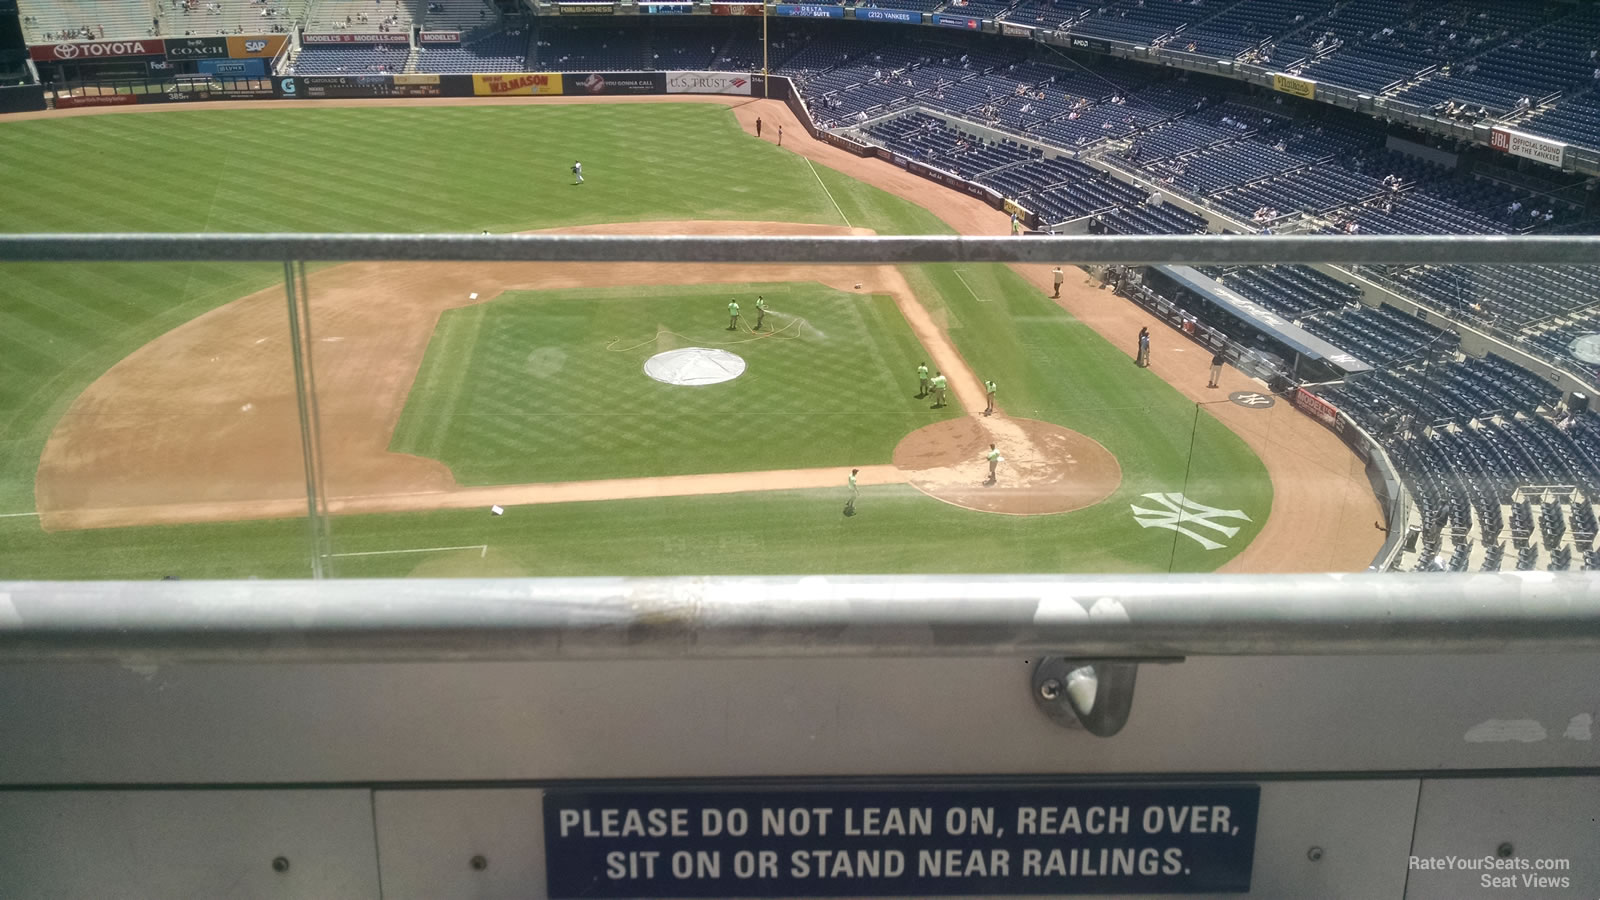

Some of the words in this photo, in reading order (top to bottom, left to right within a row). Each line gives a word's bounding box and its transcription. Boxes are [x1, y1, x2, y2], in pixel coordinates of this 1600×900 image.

[884, 12, 910, 20] YANKEES
[80, 42, 145, 56] TOYOTA
[171, 46, 223, 55] COACH
[245, 42, 266, 52] SAP
[150, 61, 174, 70] FedEx
[281, 78, 296, 93] G
[670, 78, 690, 88] U.S.
[691, 78, 728, 88] TRUST
[1492, 131, 1509, 149] JBL
[1512, 137, 1538, 150] OFFICIAL
[1539, 143, 1561, 155] SOUND
[1521, 146, 1532, 155] THE
[1534, 149, 1560, 162] YANKEES
[560, 808, 689, 837] PLEASE
[702, 808, 748, 837] DO
[761, 807, 833, 836] NOT
[844, 807, 932, 836] LEAN
[946, 807, 1004, 839] ON,
[1017, 806, 1130, 835] REACH
[1143, 805, 1240, 837] OVER,
[606, 851, 660, 880] SIT
[671, 851, 721, 879] ON
[733, 850, 779, 879] OR
[790, 850, 905, 878] STAND
[918, 849, 1010, 877] NEAR
[1022, 848, 1191, 876] RAILINGS.
